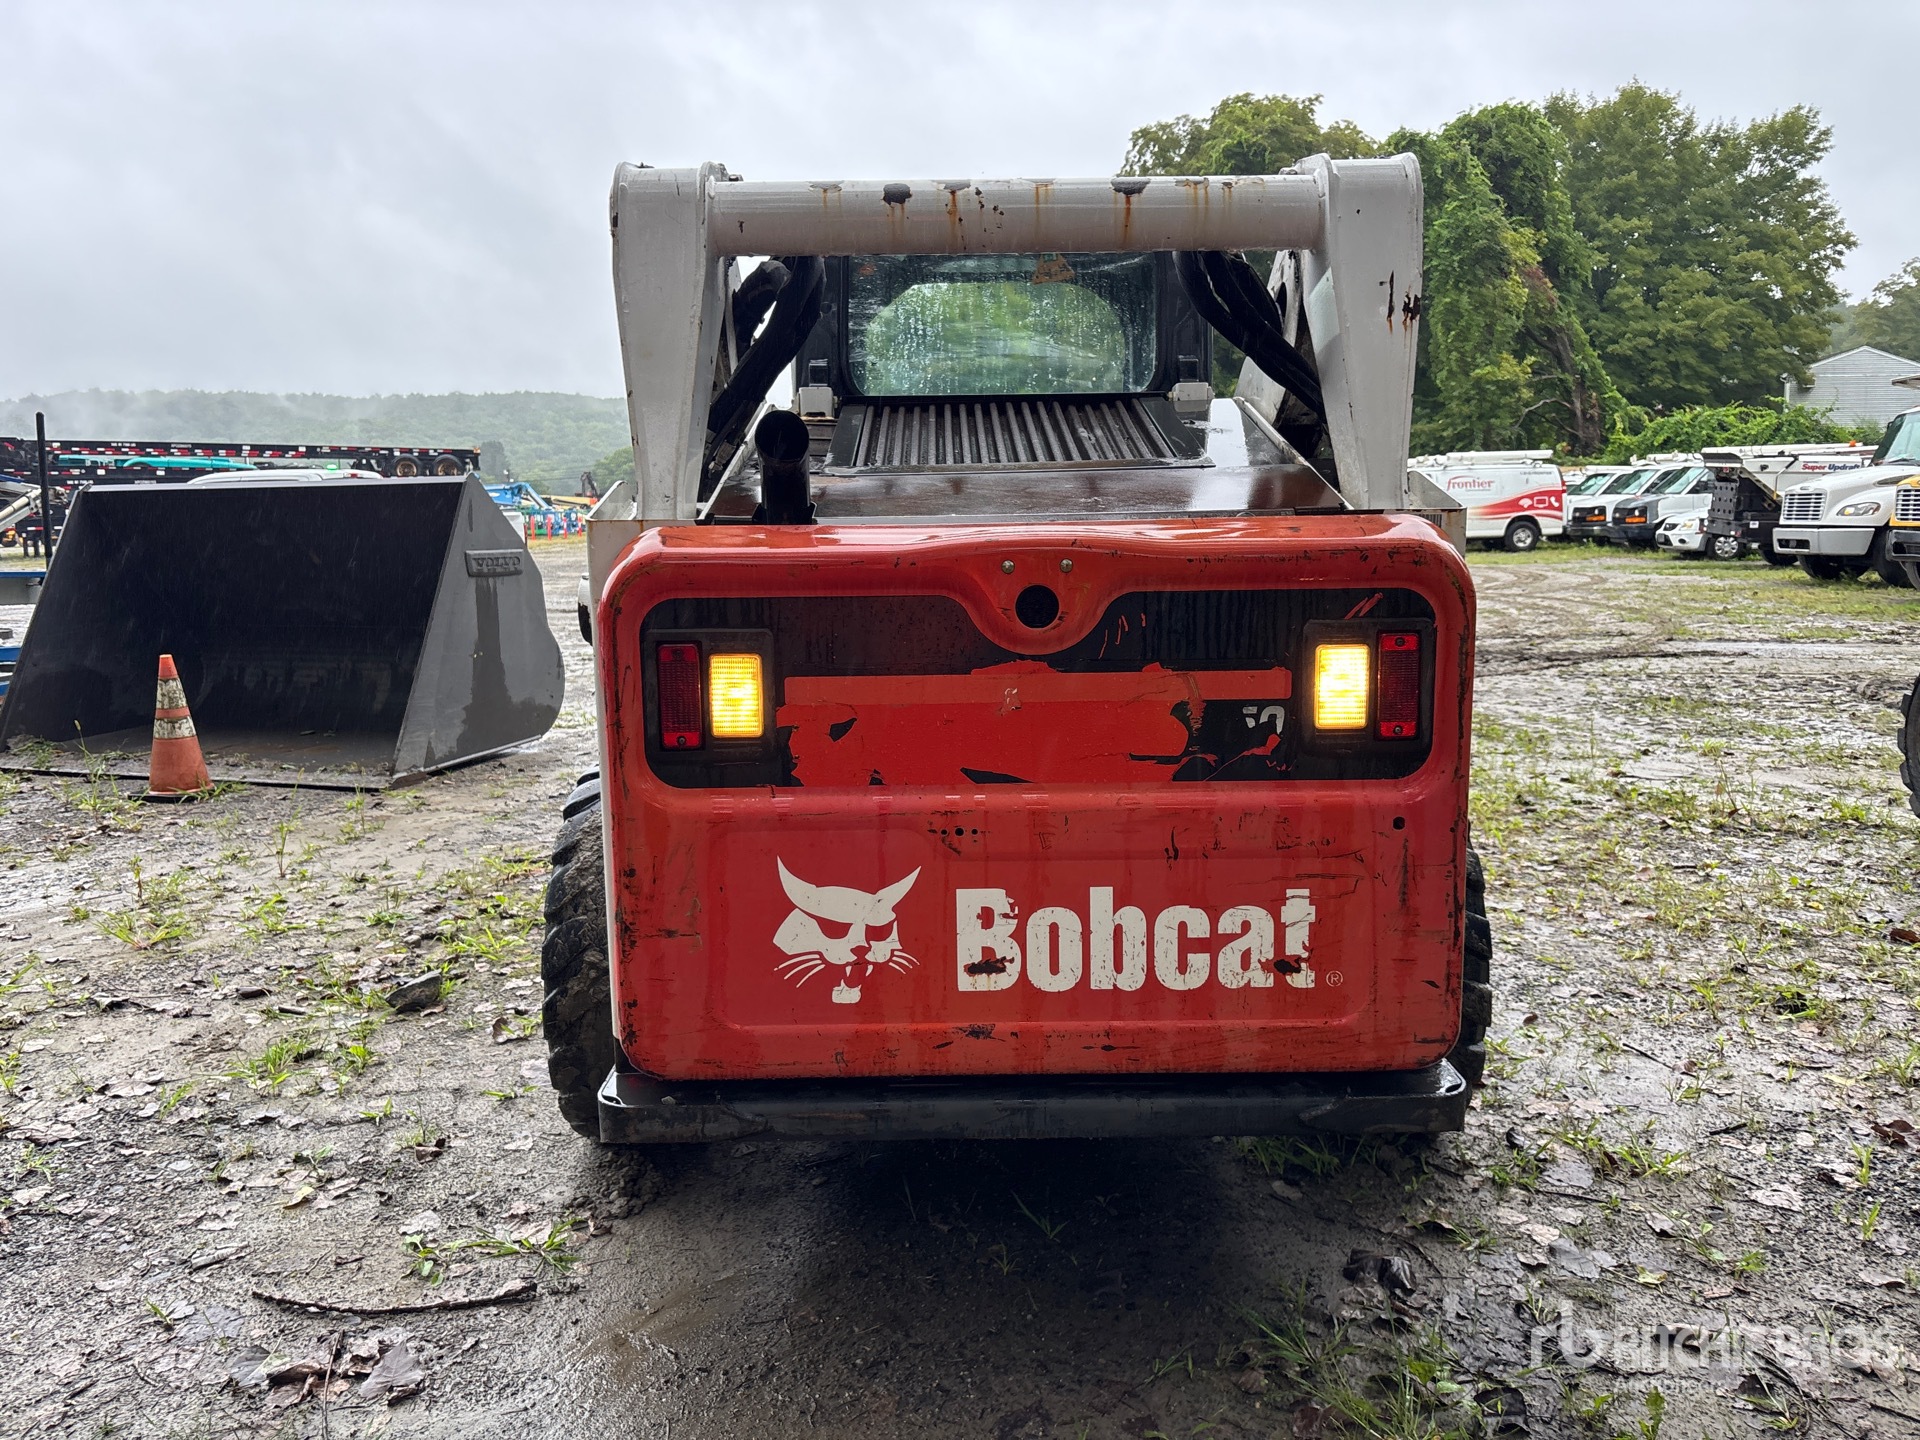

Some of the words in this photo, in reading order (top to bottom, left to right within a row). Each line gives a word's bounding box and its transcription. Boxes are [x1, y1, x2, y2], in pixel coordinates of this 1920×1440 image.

[1801, 463, 1827, 471] Super
[1447, 475, 1495, 491] frontier
[955, 886, 1316, 993] Bobcat
